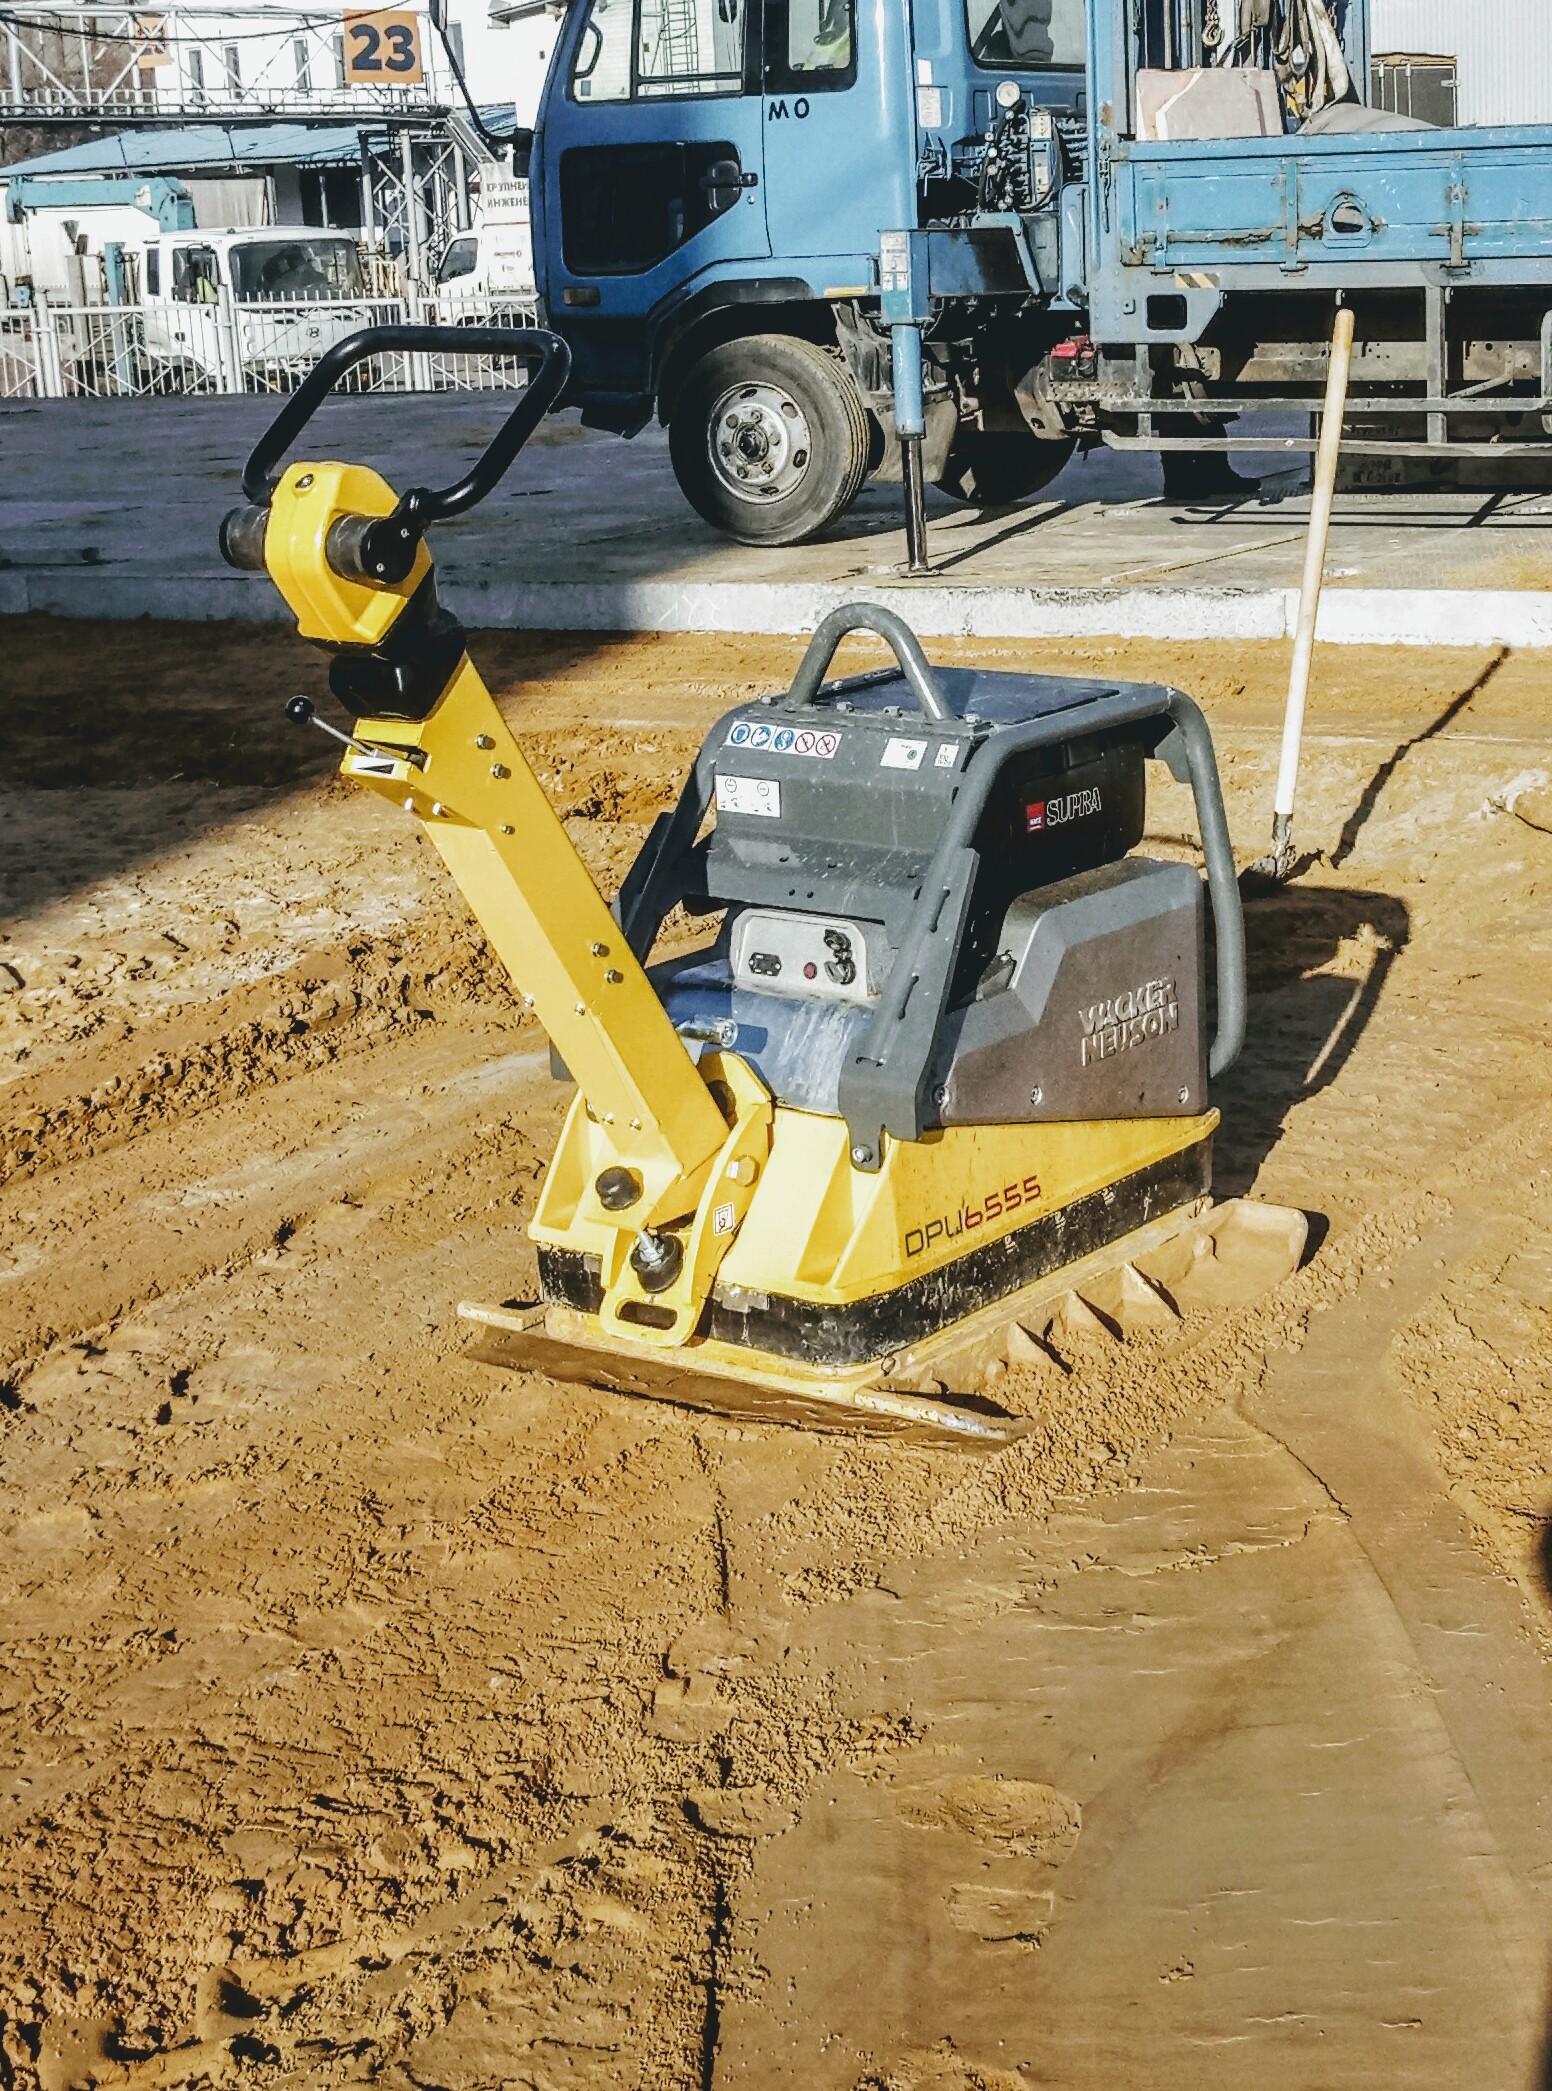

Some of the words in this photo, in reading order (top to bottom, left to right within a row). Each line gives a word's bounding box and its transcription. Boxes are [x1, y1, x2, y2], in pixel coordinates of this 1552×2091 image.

[349, 24, 416, 72] 23
[1046, 787, 1102, 826] SUPRA
[1078, 977, 1179, 1036] WACKER
[1081, 1002, 1179, 1067] NEUSON
[904, 1174, 1042, 1258] DPU6555
